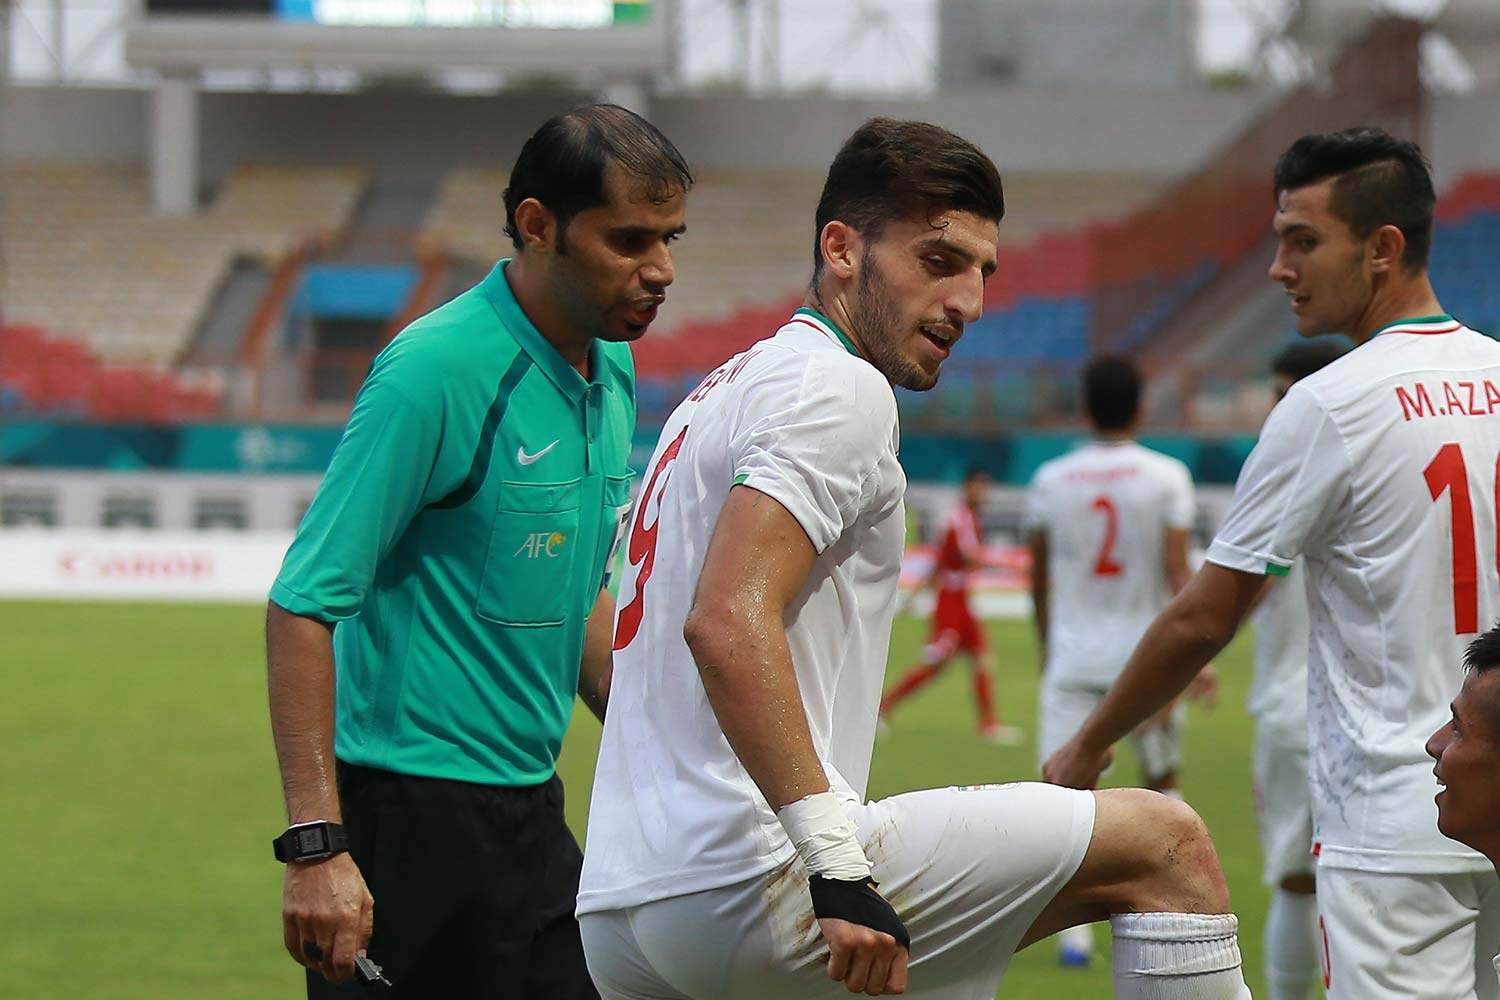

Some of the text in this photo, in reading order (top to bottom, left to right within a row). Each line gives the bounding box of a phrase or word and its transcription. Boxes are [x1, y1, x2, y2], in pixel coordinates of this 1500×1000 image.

[513, 531, 567, 558] AFC
[613, 424, 689, 650] 9
[1091, 495, 1124, 577] 2
